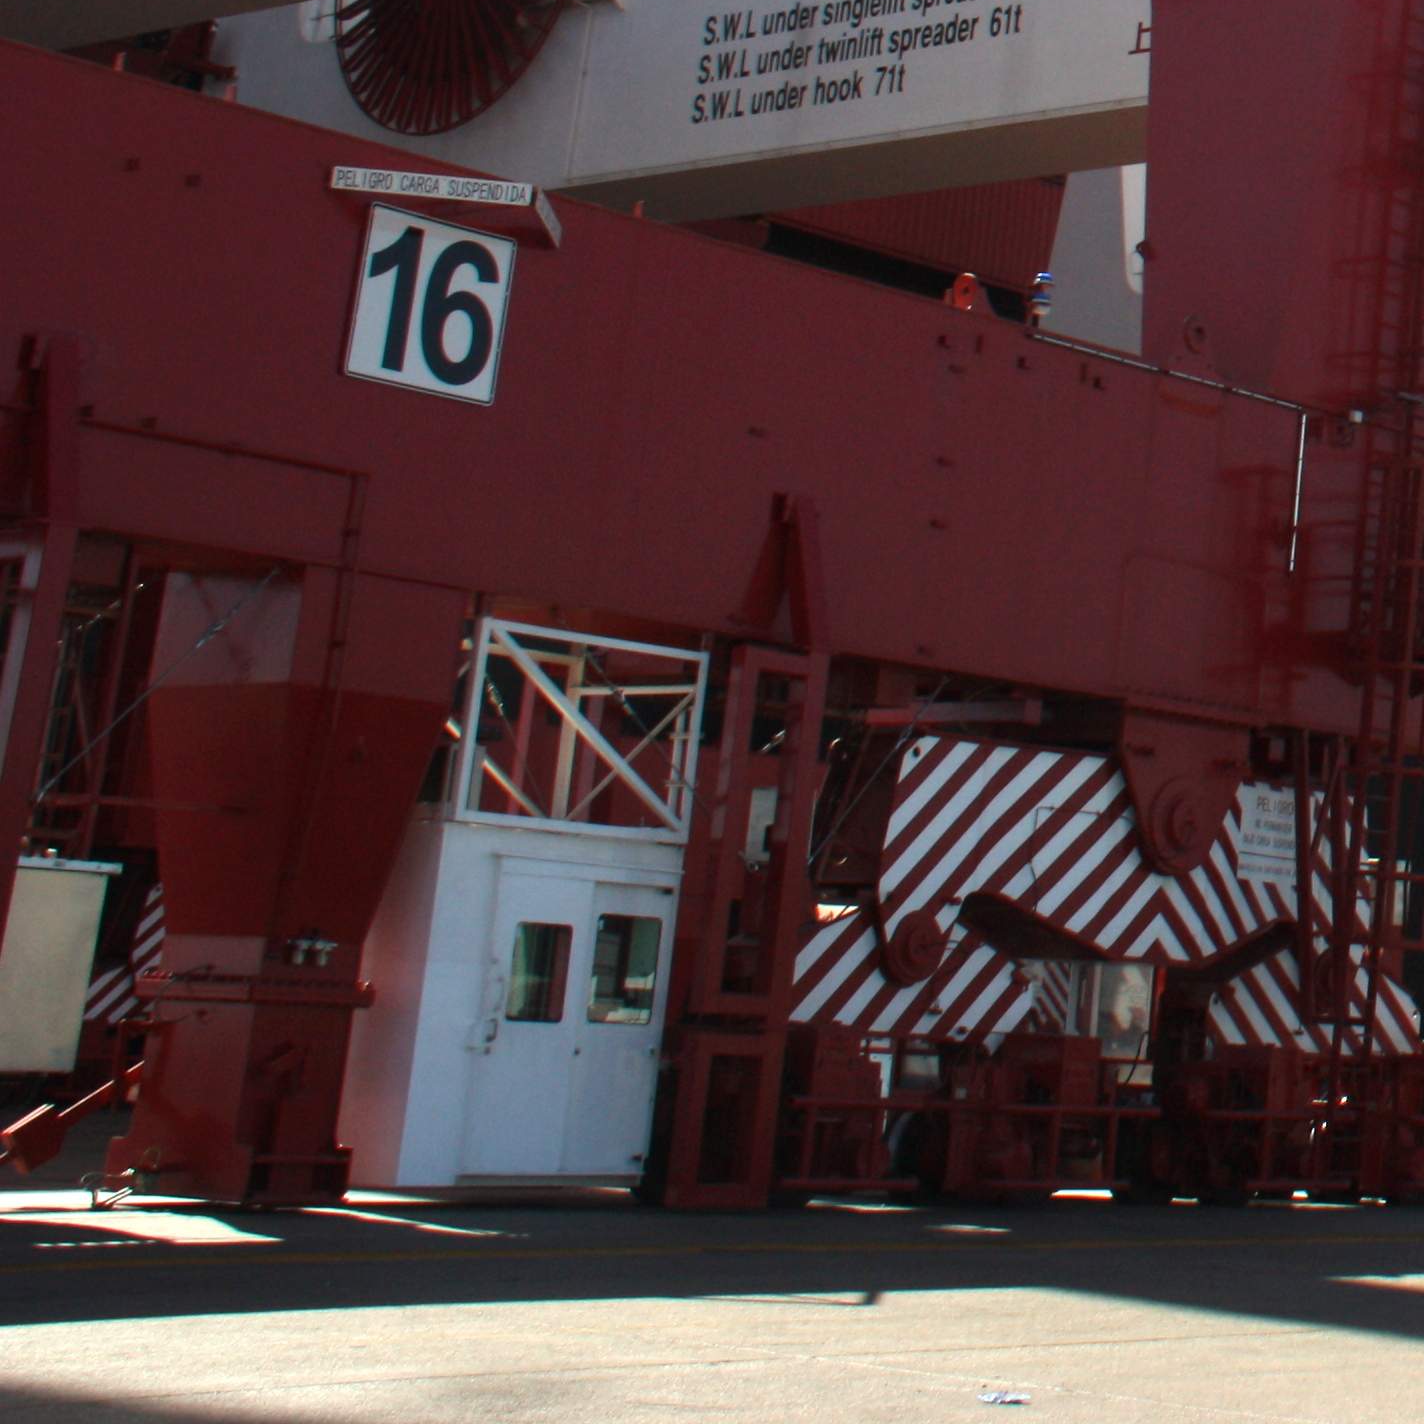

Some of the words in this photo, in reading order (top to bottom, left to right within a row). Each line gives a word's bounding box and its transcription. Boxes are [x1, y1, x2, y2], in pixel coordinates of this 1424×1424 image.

[697, 49, 750, 85] S.W.L
[756, 41, 813, 74] under
[817, 27, 884, 65] twinlift
[888, 14, 979, 59] spreader
[990, 4, 1023, 37] 61t
[703, 10, 756, 46] S.W.L
[762, 2, 819, 36] under
[691, 87, 744, 124] S.W.L
[750, 80, 808, 115] under
[812, 70, 864, 106] hook
[873, 63, 906, 96] 71t
[335, 170, 393, 190] PELIGRO
[400, 176, 440, 193] CARGA
[448, 182, 527, 202] SUSPENDIDA
[368, 225, 499, 386] 16
